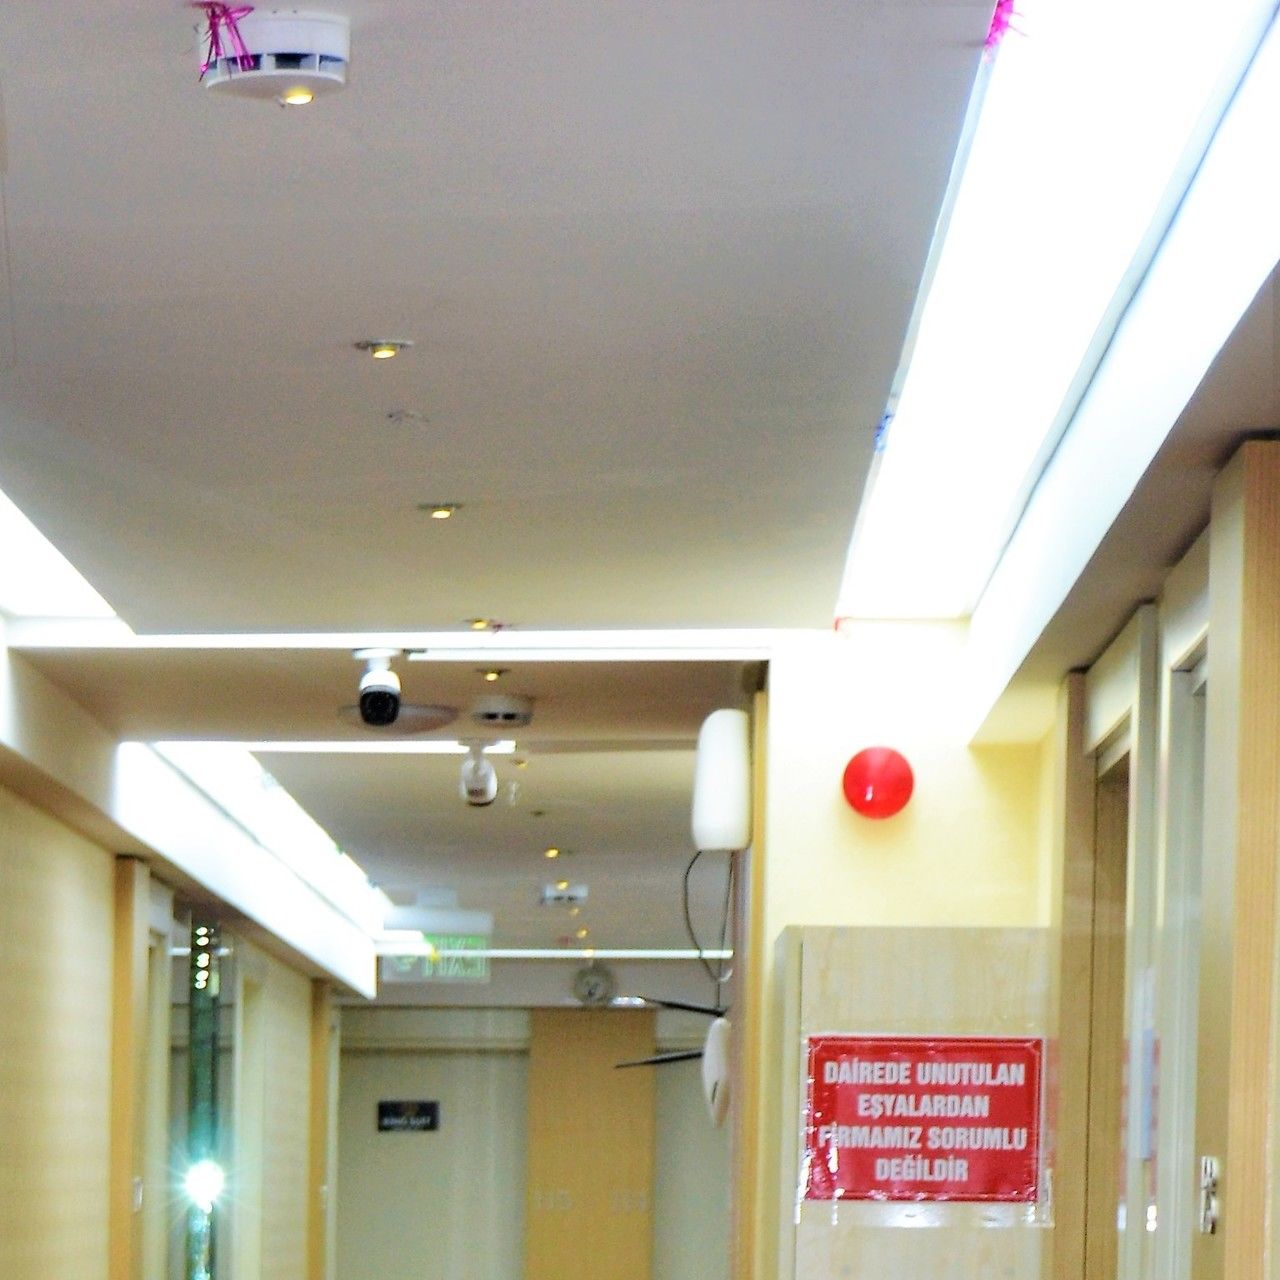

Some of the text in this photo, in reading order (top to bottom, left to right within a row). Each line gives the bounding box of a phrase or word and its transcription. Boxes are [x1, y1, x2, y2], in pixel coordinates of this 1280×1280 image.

[825, 1058, 1025, 1085] DAİREDE UNUTULAN
[858, 1095, 988, 1118] EŞYALARDAN
[928, 1126, 1027, 1150] SORUMLU
[876, 1155, 968, 1181] DEĞİLDİR
